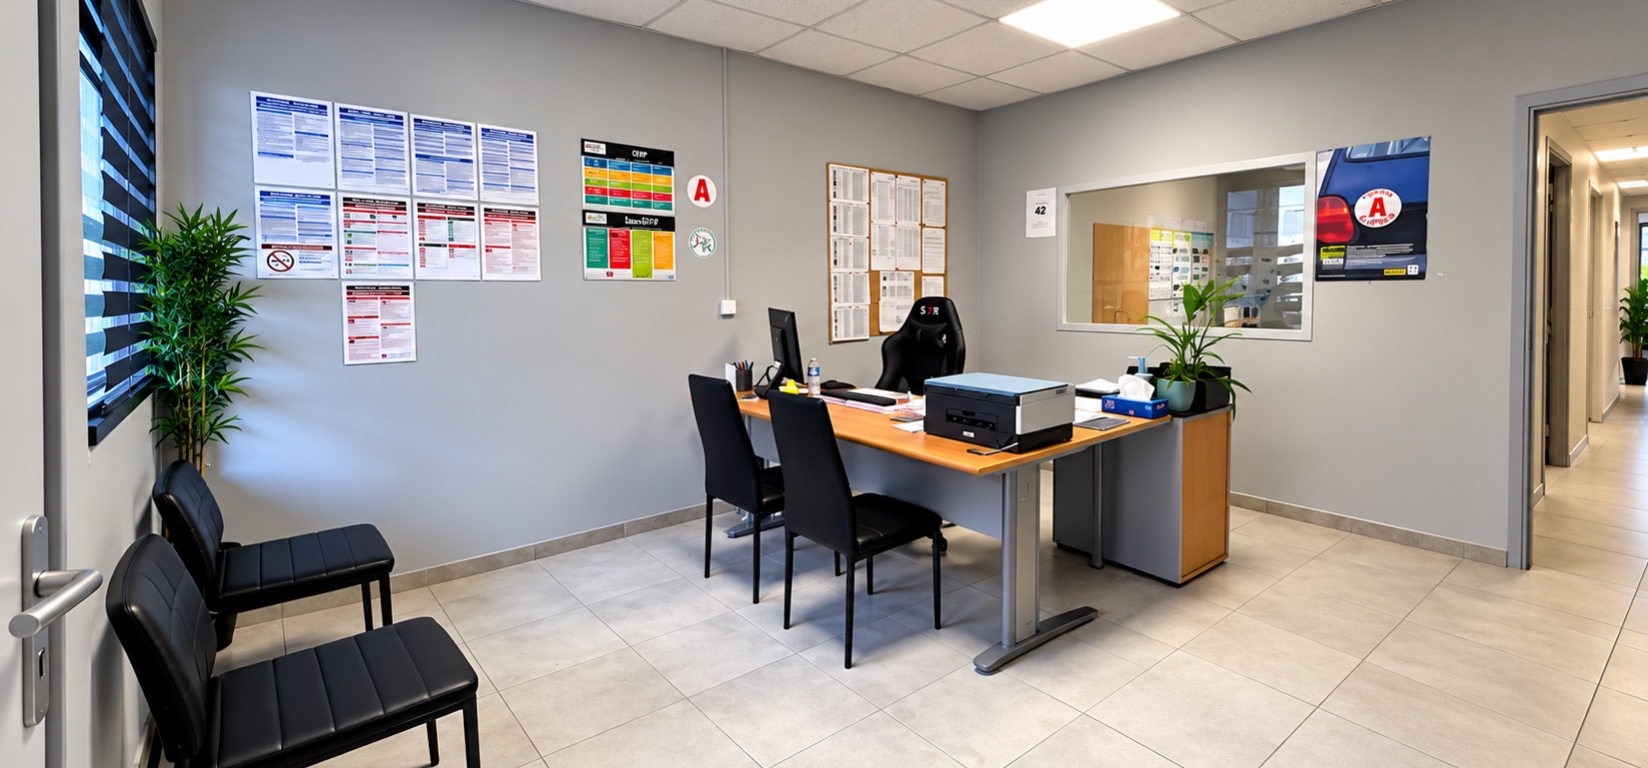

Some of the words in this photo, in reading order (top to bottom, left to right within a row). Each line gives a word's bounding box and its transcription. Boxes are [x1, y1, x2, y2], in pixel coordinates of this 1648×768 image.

[694, 179, 711, 202] A
[1034, 206, 1046, 215] 42
[1368, 197, 1387, 217] A
